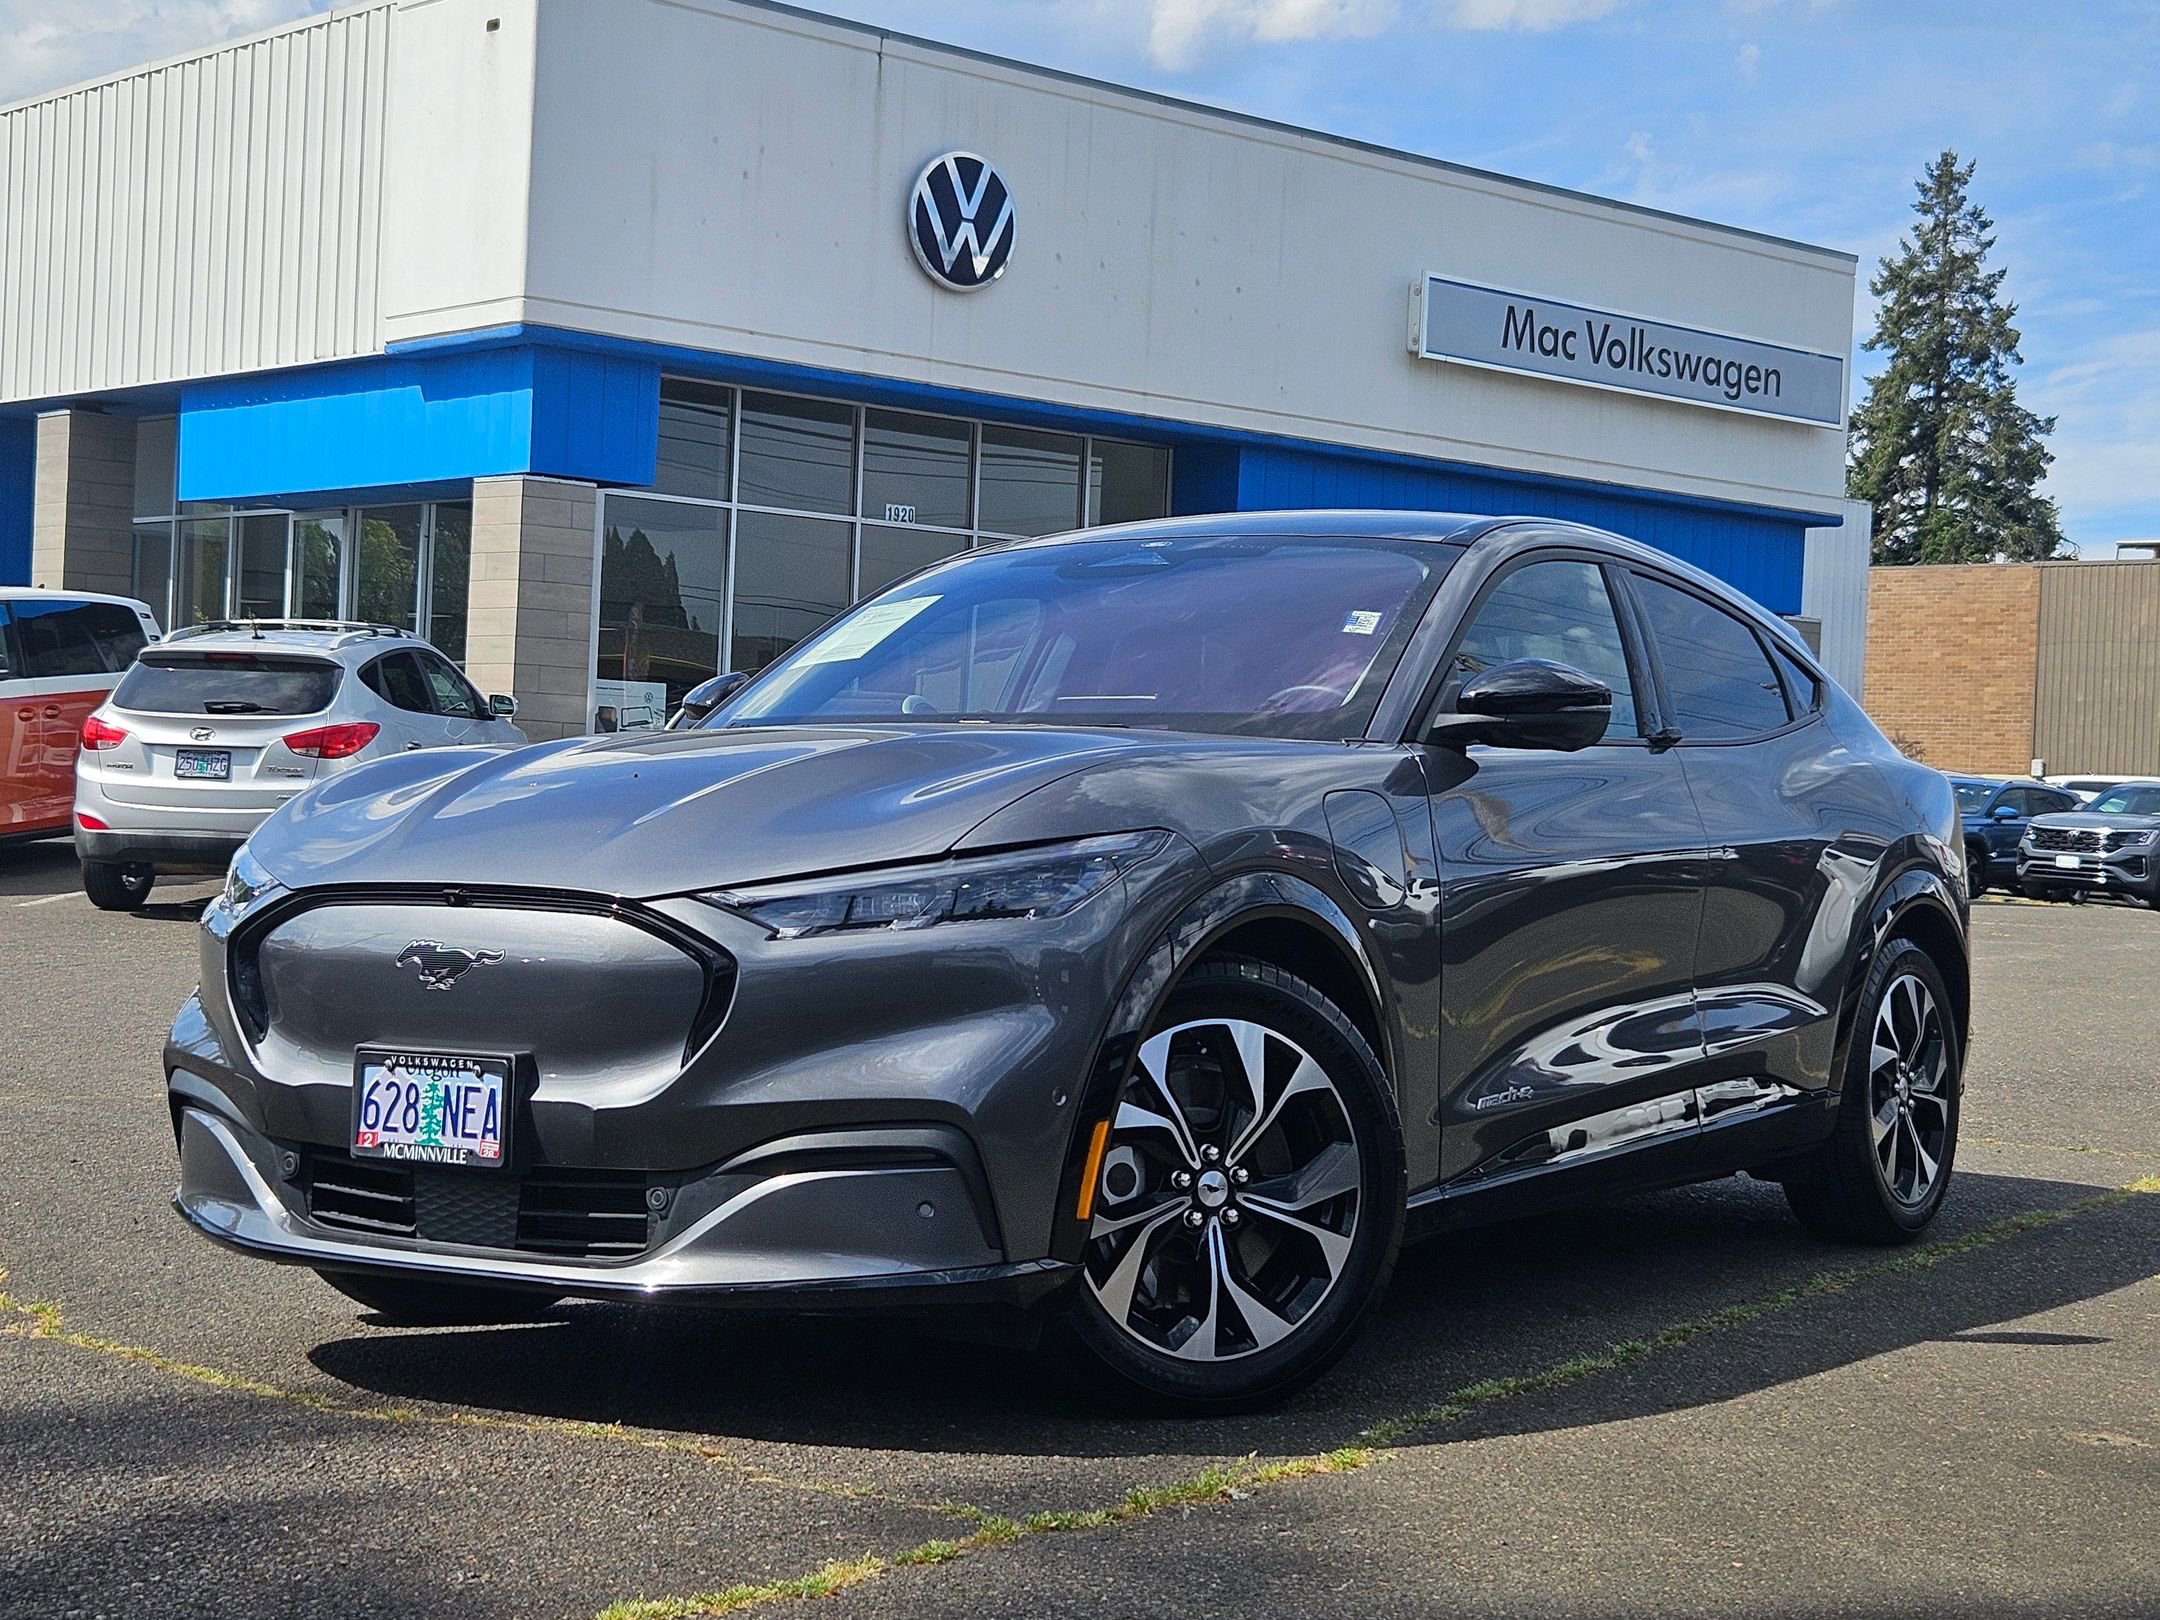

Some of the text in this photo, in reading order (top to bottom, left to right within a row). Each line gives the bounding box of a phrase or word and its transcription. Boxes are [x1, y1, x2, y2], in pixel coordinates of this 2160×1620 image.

[1501, 305, 1781, 401] Mac Volkswagen
[887, 506, 915, 523] 1920
[178, 756, 199, 771] 250
[391, 1055, 474, 1070] VOLKSWAGEN
[363, 1079, 498, 1141] 628 NEA
[363, 1134, 373, 1146] 2
[383, 1143, 468, 1165] MCMINNVILLE
